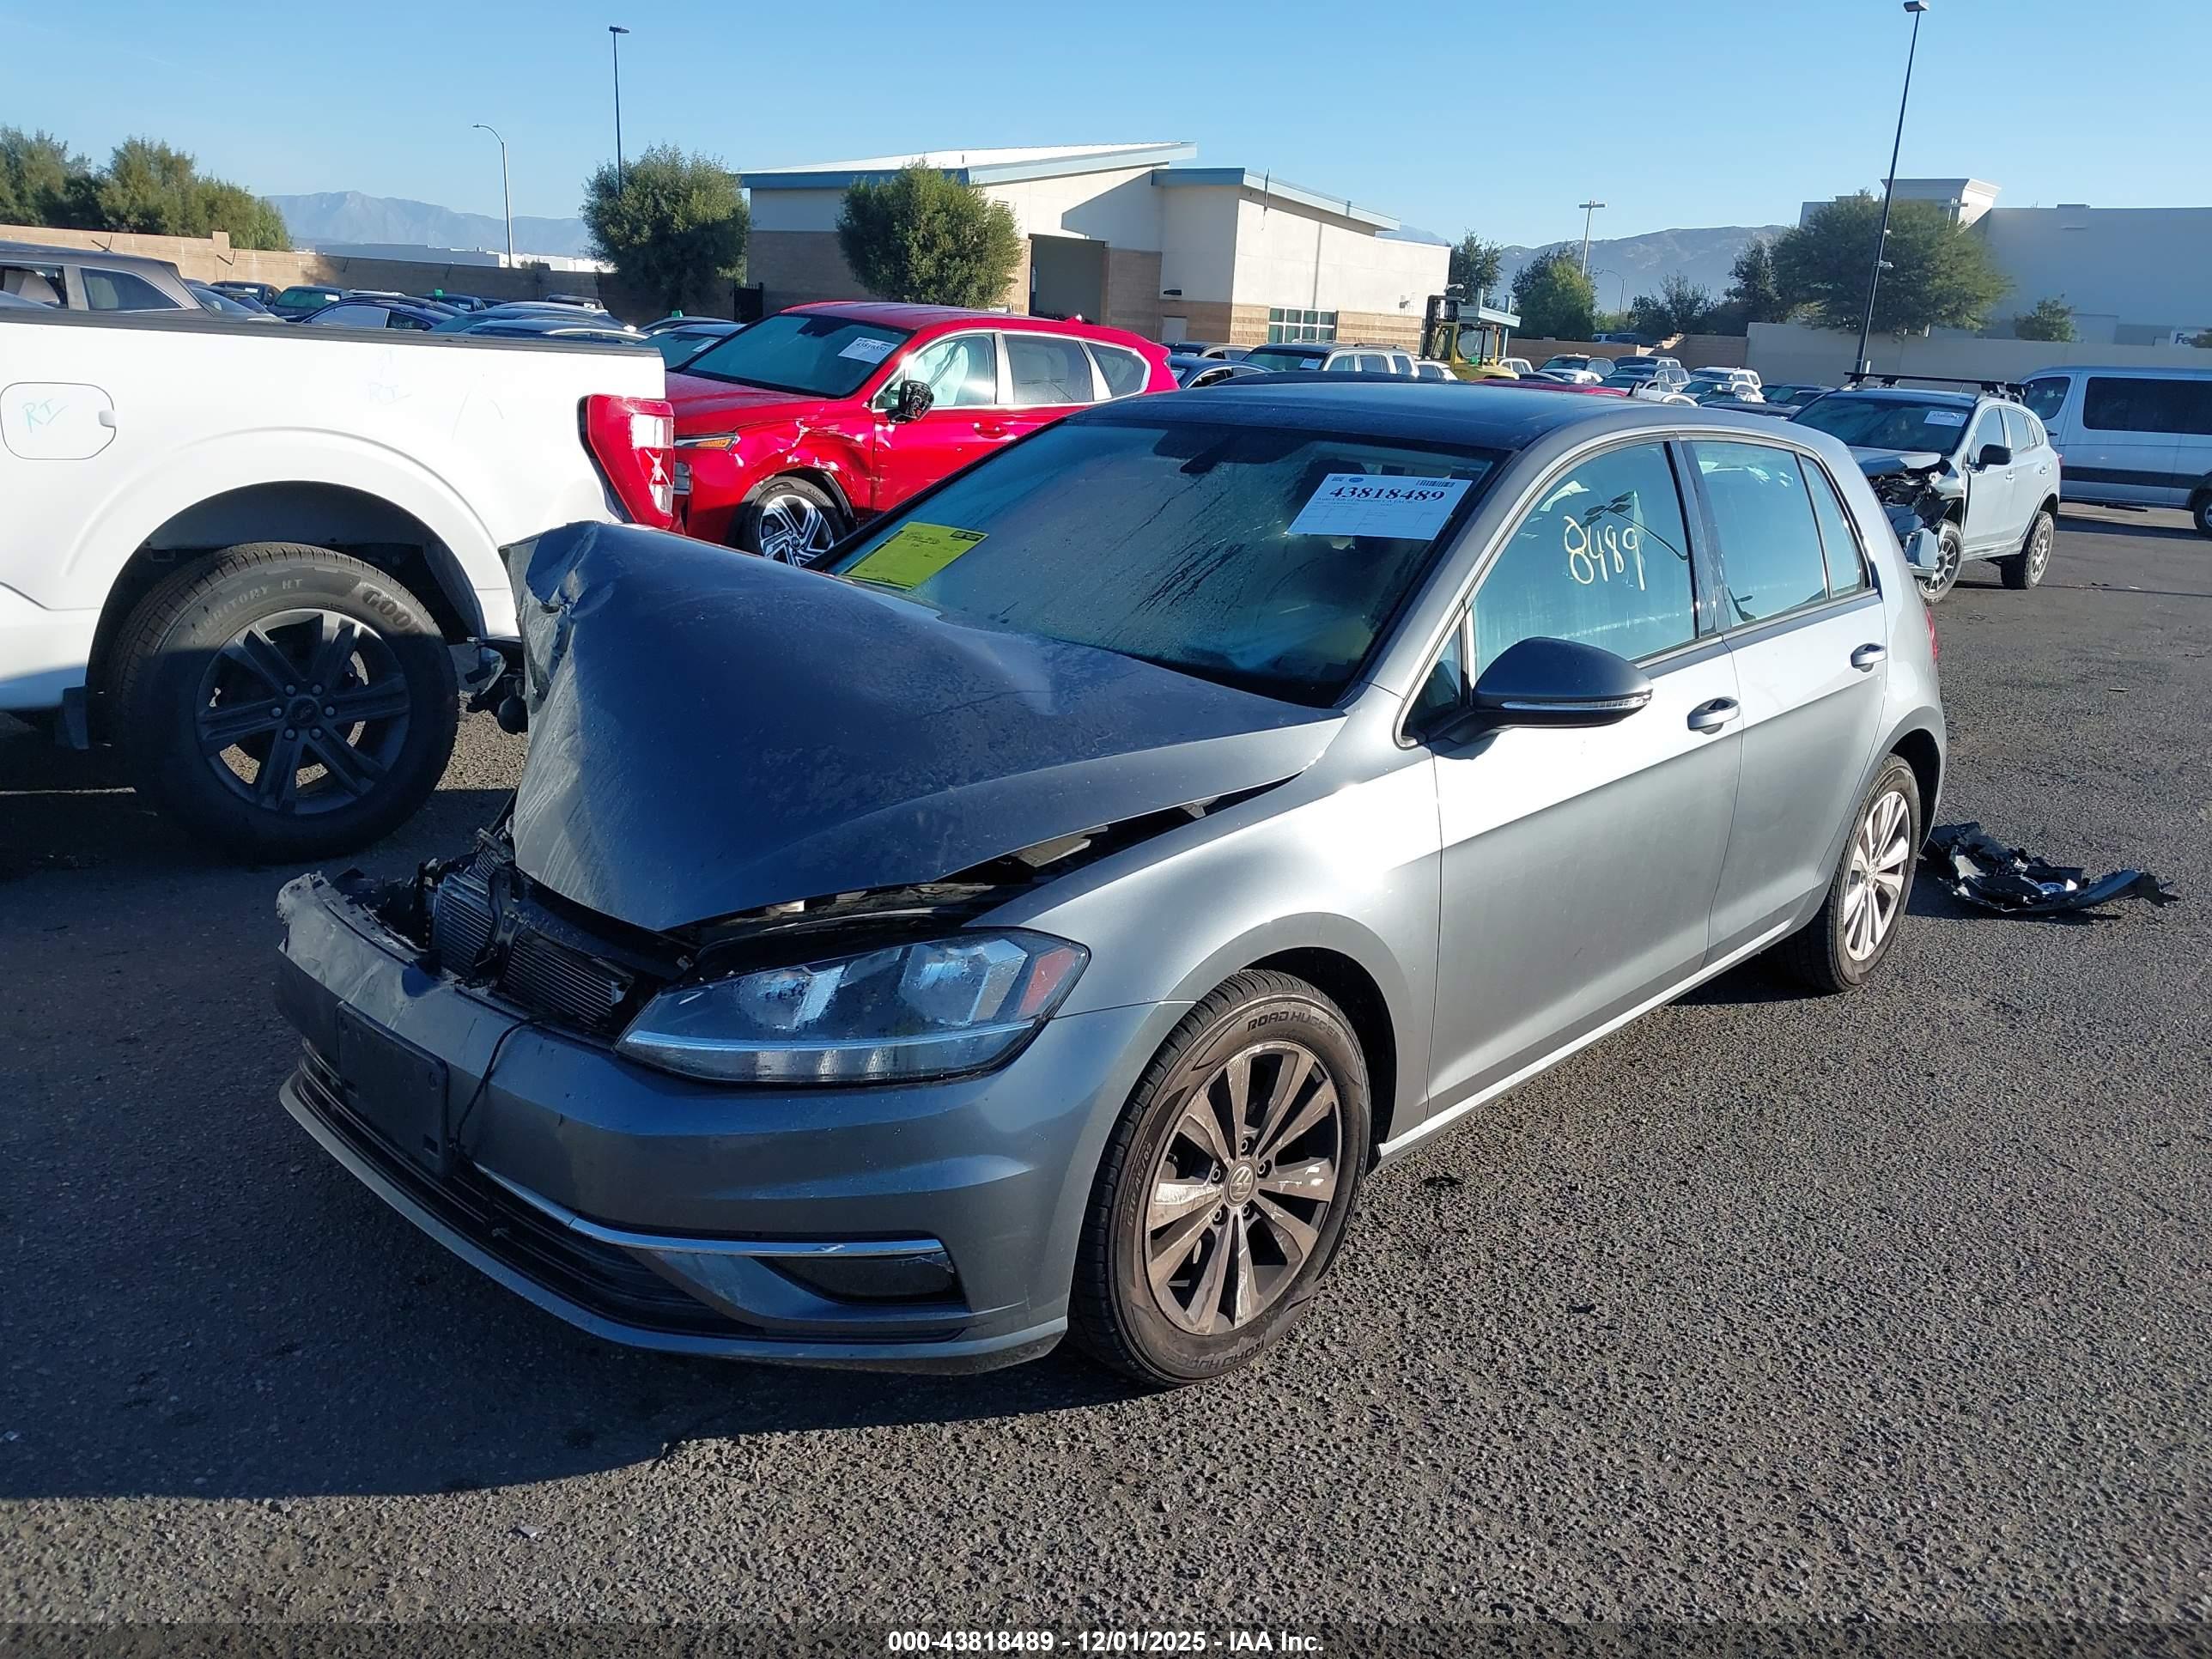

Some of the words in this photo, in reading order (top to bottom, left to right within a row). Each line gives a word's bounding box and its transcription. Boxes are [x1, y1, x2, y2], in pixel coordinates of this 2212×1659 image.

[1329, 486, 1445, 501] 43818489
[1563, 515, 1646, 592] 8489
[1247, 1011, 1290, 1032] ROAD
